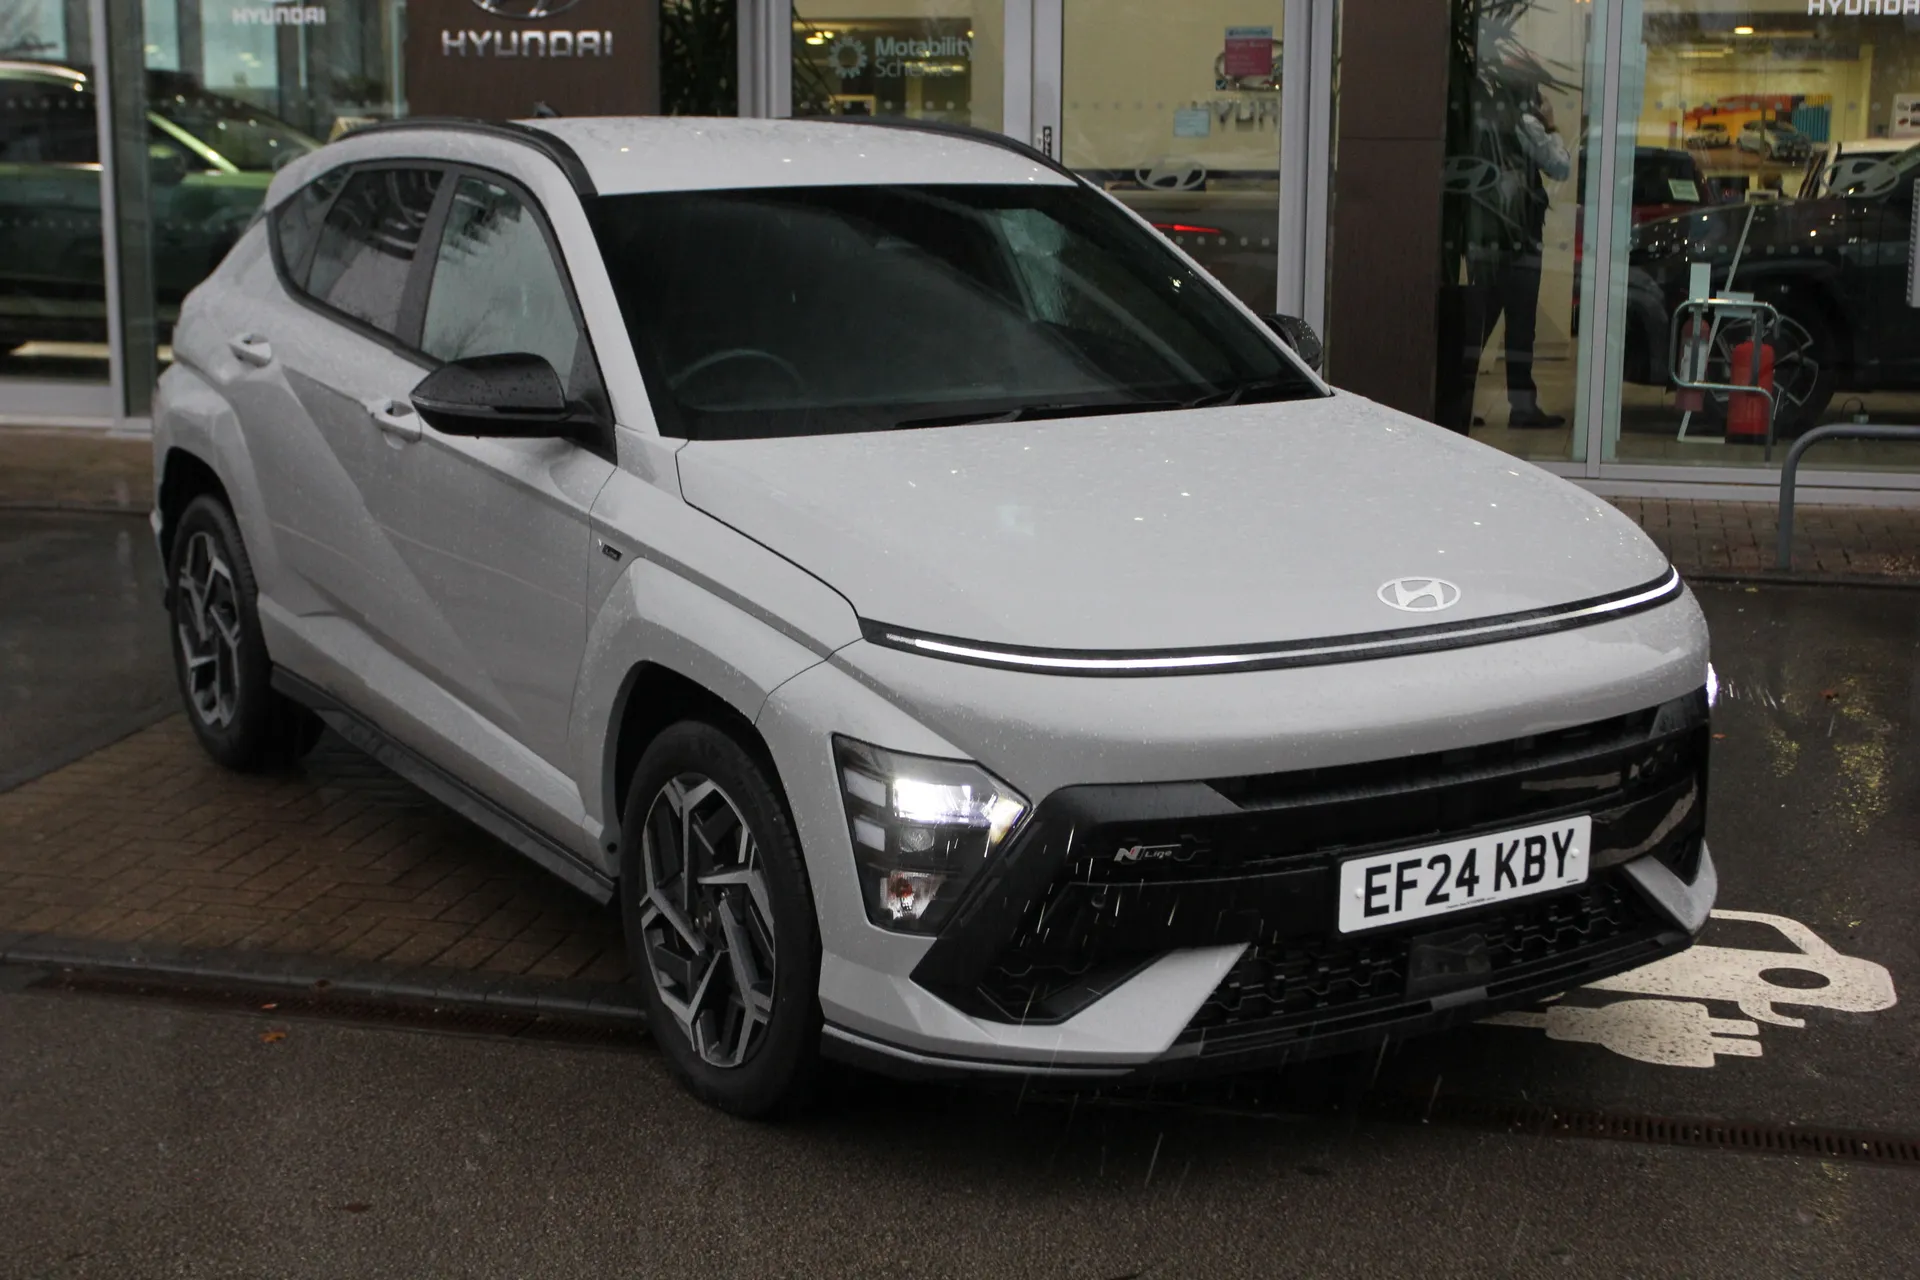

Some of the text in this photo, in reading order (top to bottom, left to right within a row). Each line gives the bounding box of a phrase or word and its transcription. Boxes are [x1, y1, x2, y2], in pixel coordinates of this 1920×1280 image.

[232, 7, 326, 25] HYUNDAI
[441, 30, 613, 57] HYUNDAI
[874, 36, 973, 61] Motability
[1363, 828, 1574, 918] EF24 KBY
